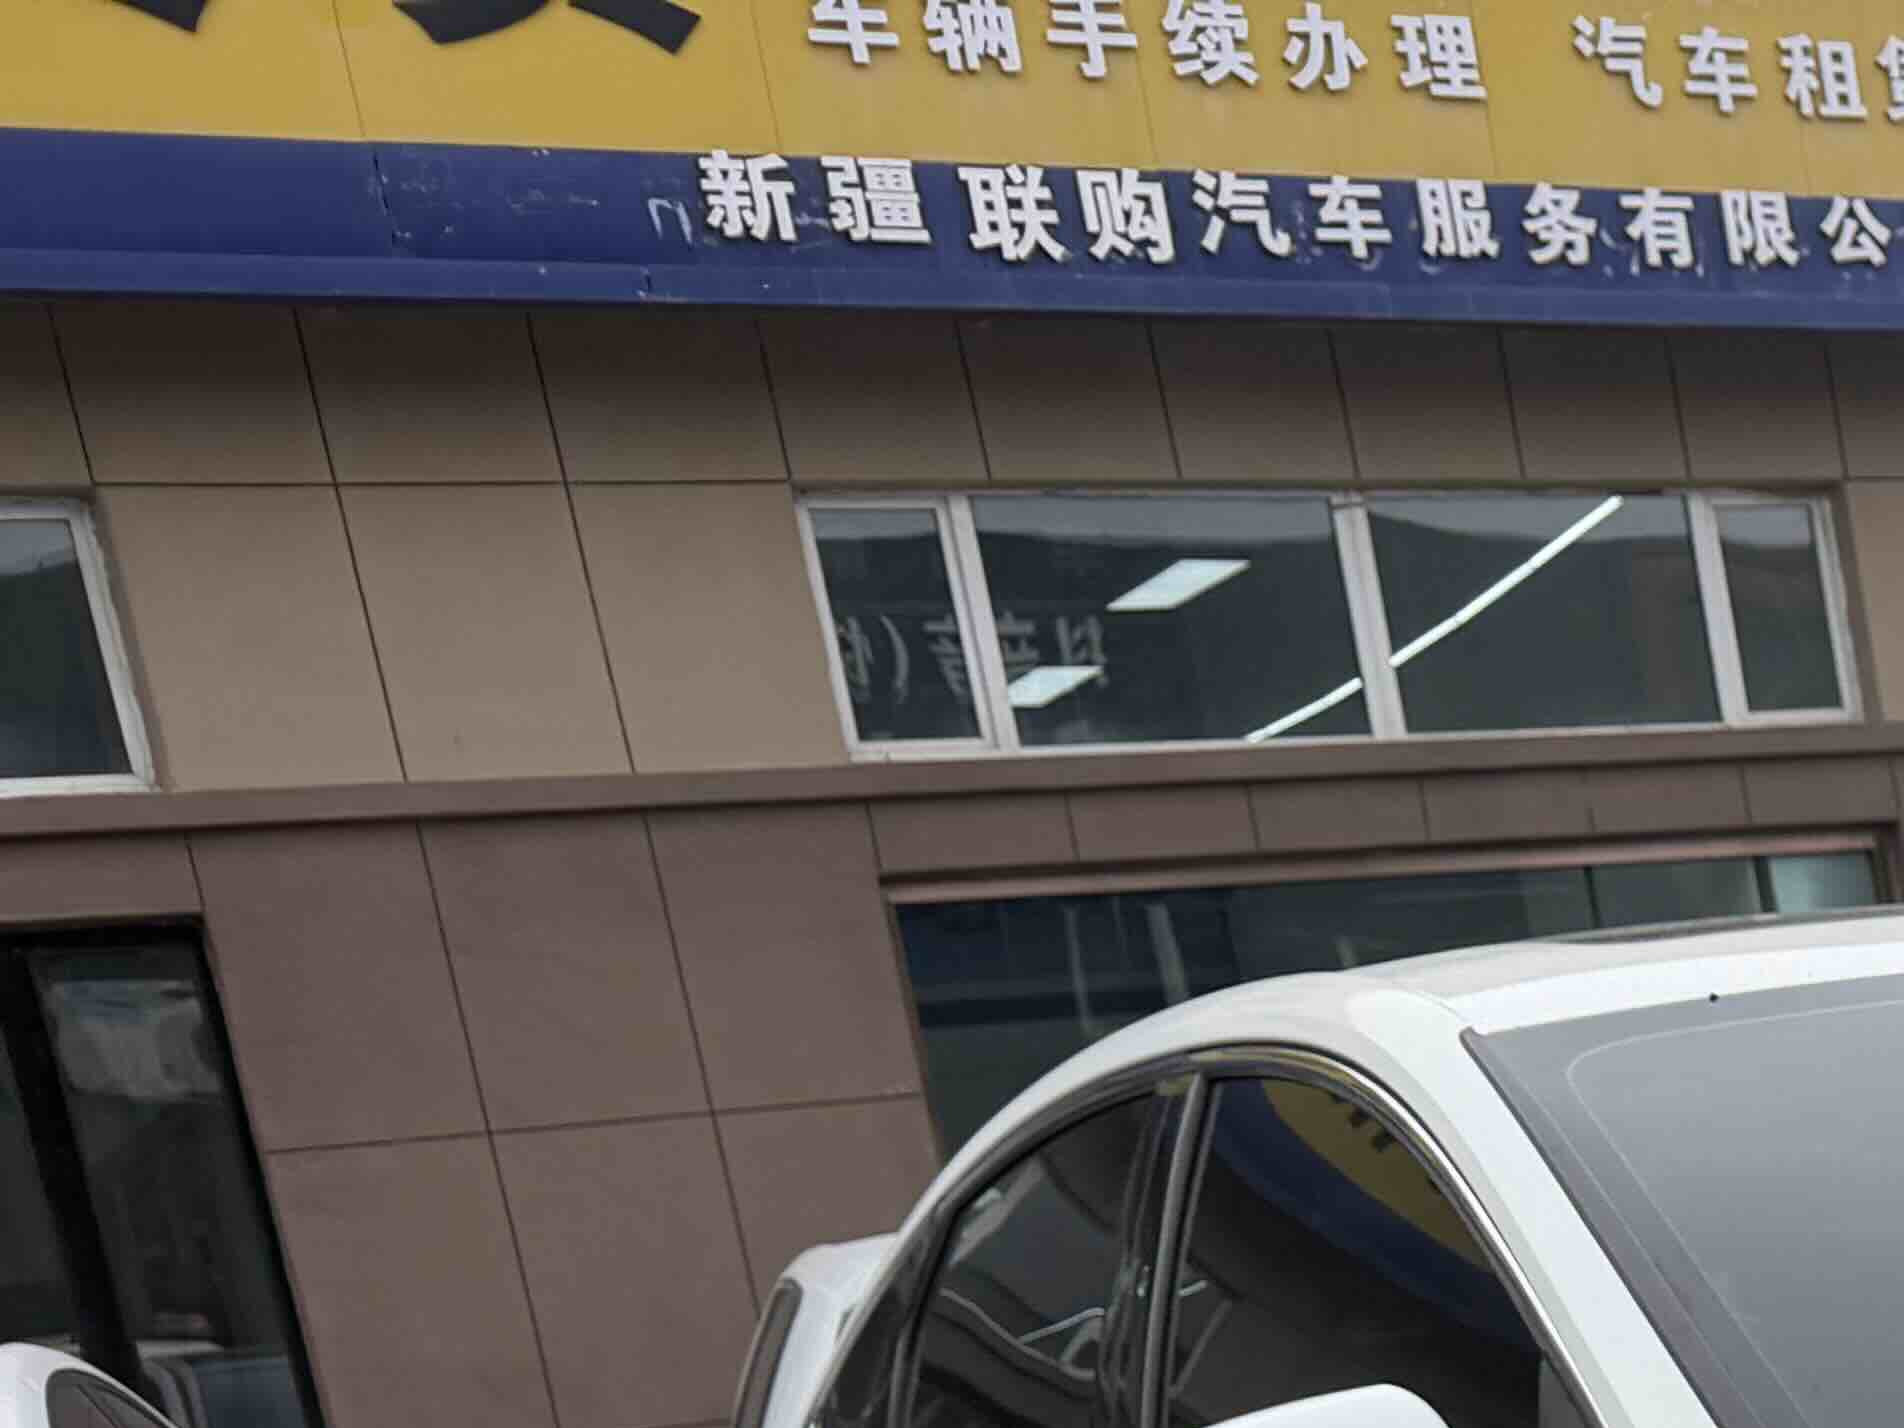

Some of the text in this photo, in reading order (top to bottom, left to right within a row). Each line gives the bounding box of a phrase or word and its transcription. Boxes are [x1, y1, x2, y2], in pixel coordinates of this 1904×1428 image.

[807, 0, 1487, 101] 车辆手续办理
